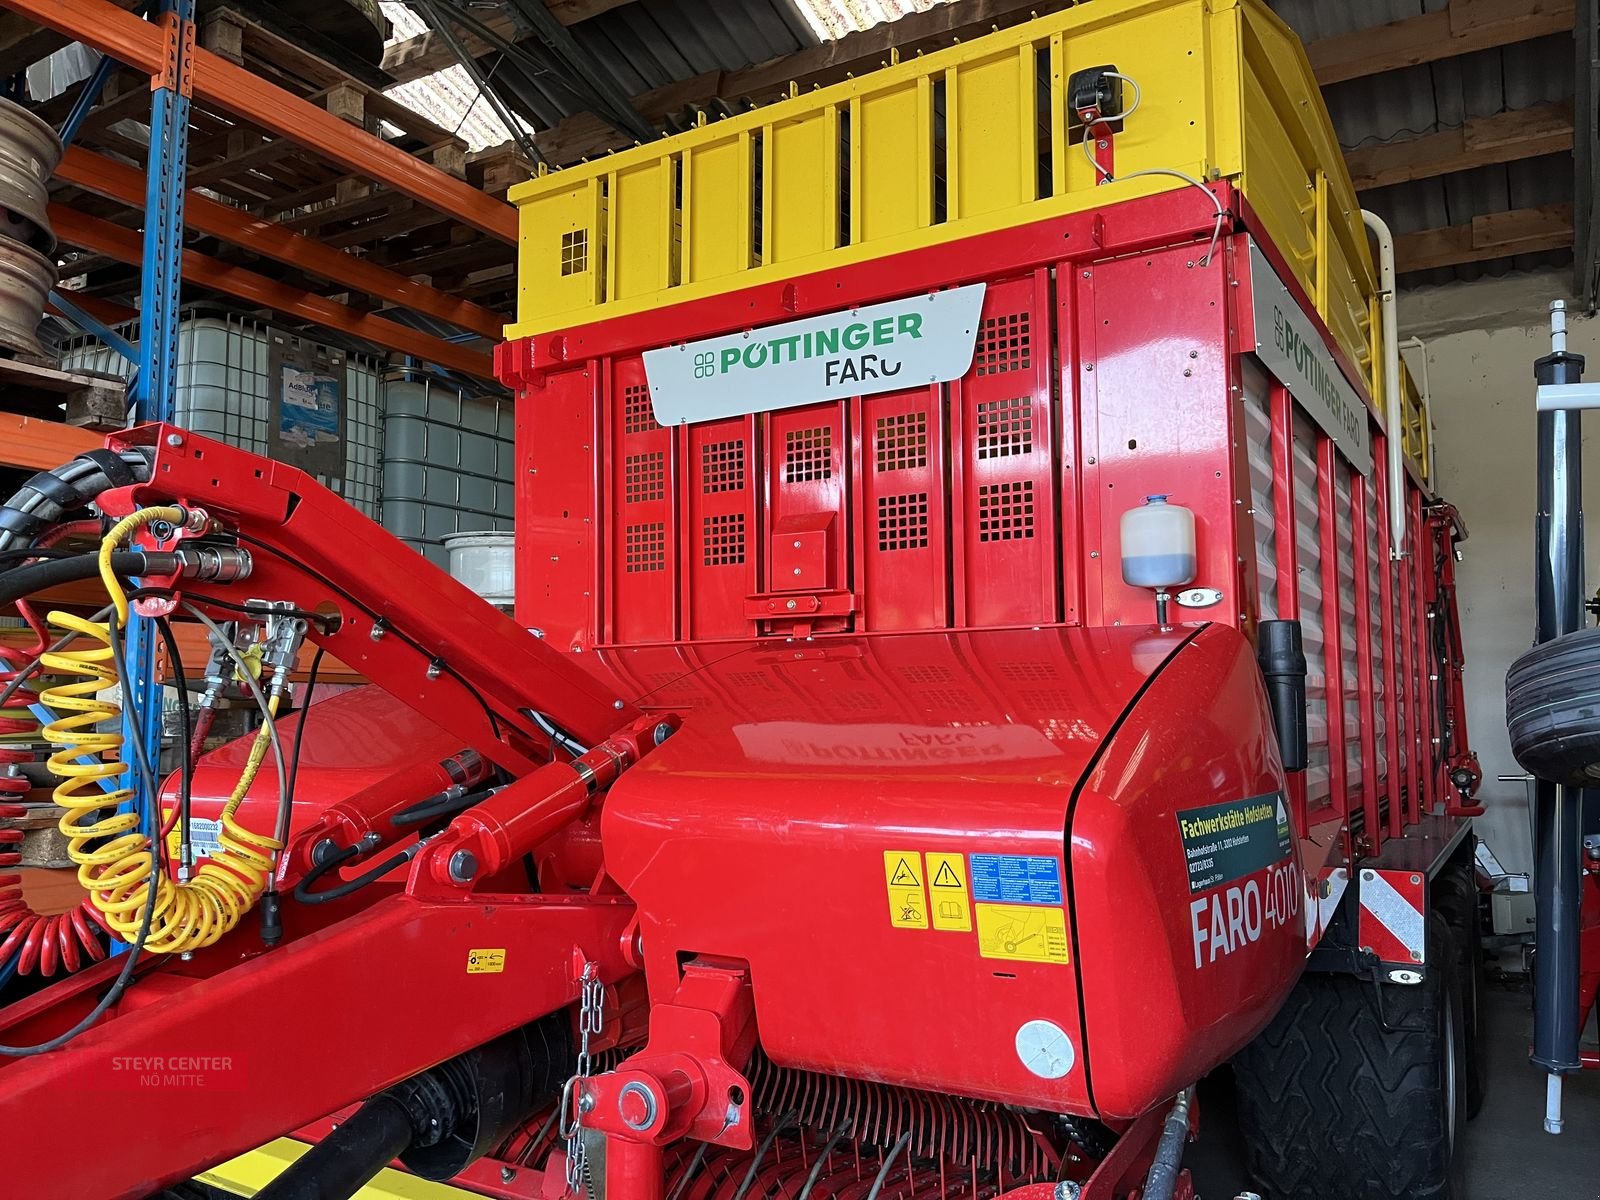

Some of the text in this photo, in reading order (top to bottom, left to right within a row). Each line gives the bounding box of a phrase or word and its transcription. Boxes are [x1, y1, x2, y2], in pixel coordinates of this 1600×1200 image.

[720, 312, 923, 373] PÖTTINGER
[1285, 319, 1360, 448] PÖTTINGER FARO
[1180, 803, 1273, 840] Fachwerkstätte Hofstetten
[1190, 862, 1299, 970] FARO 4010
